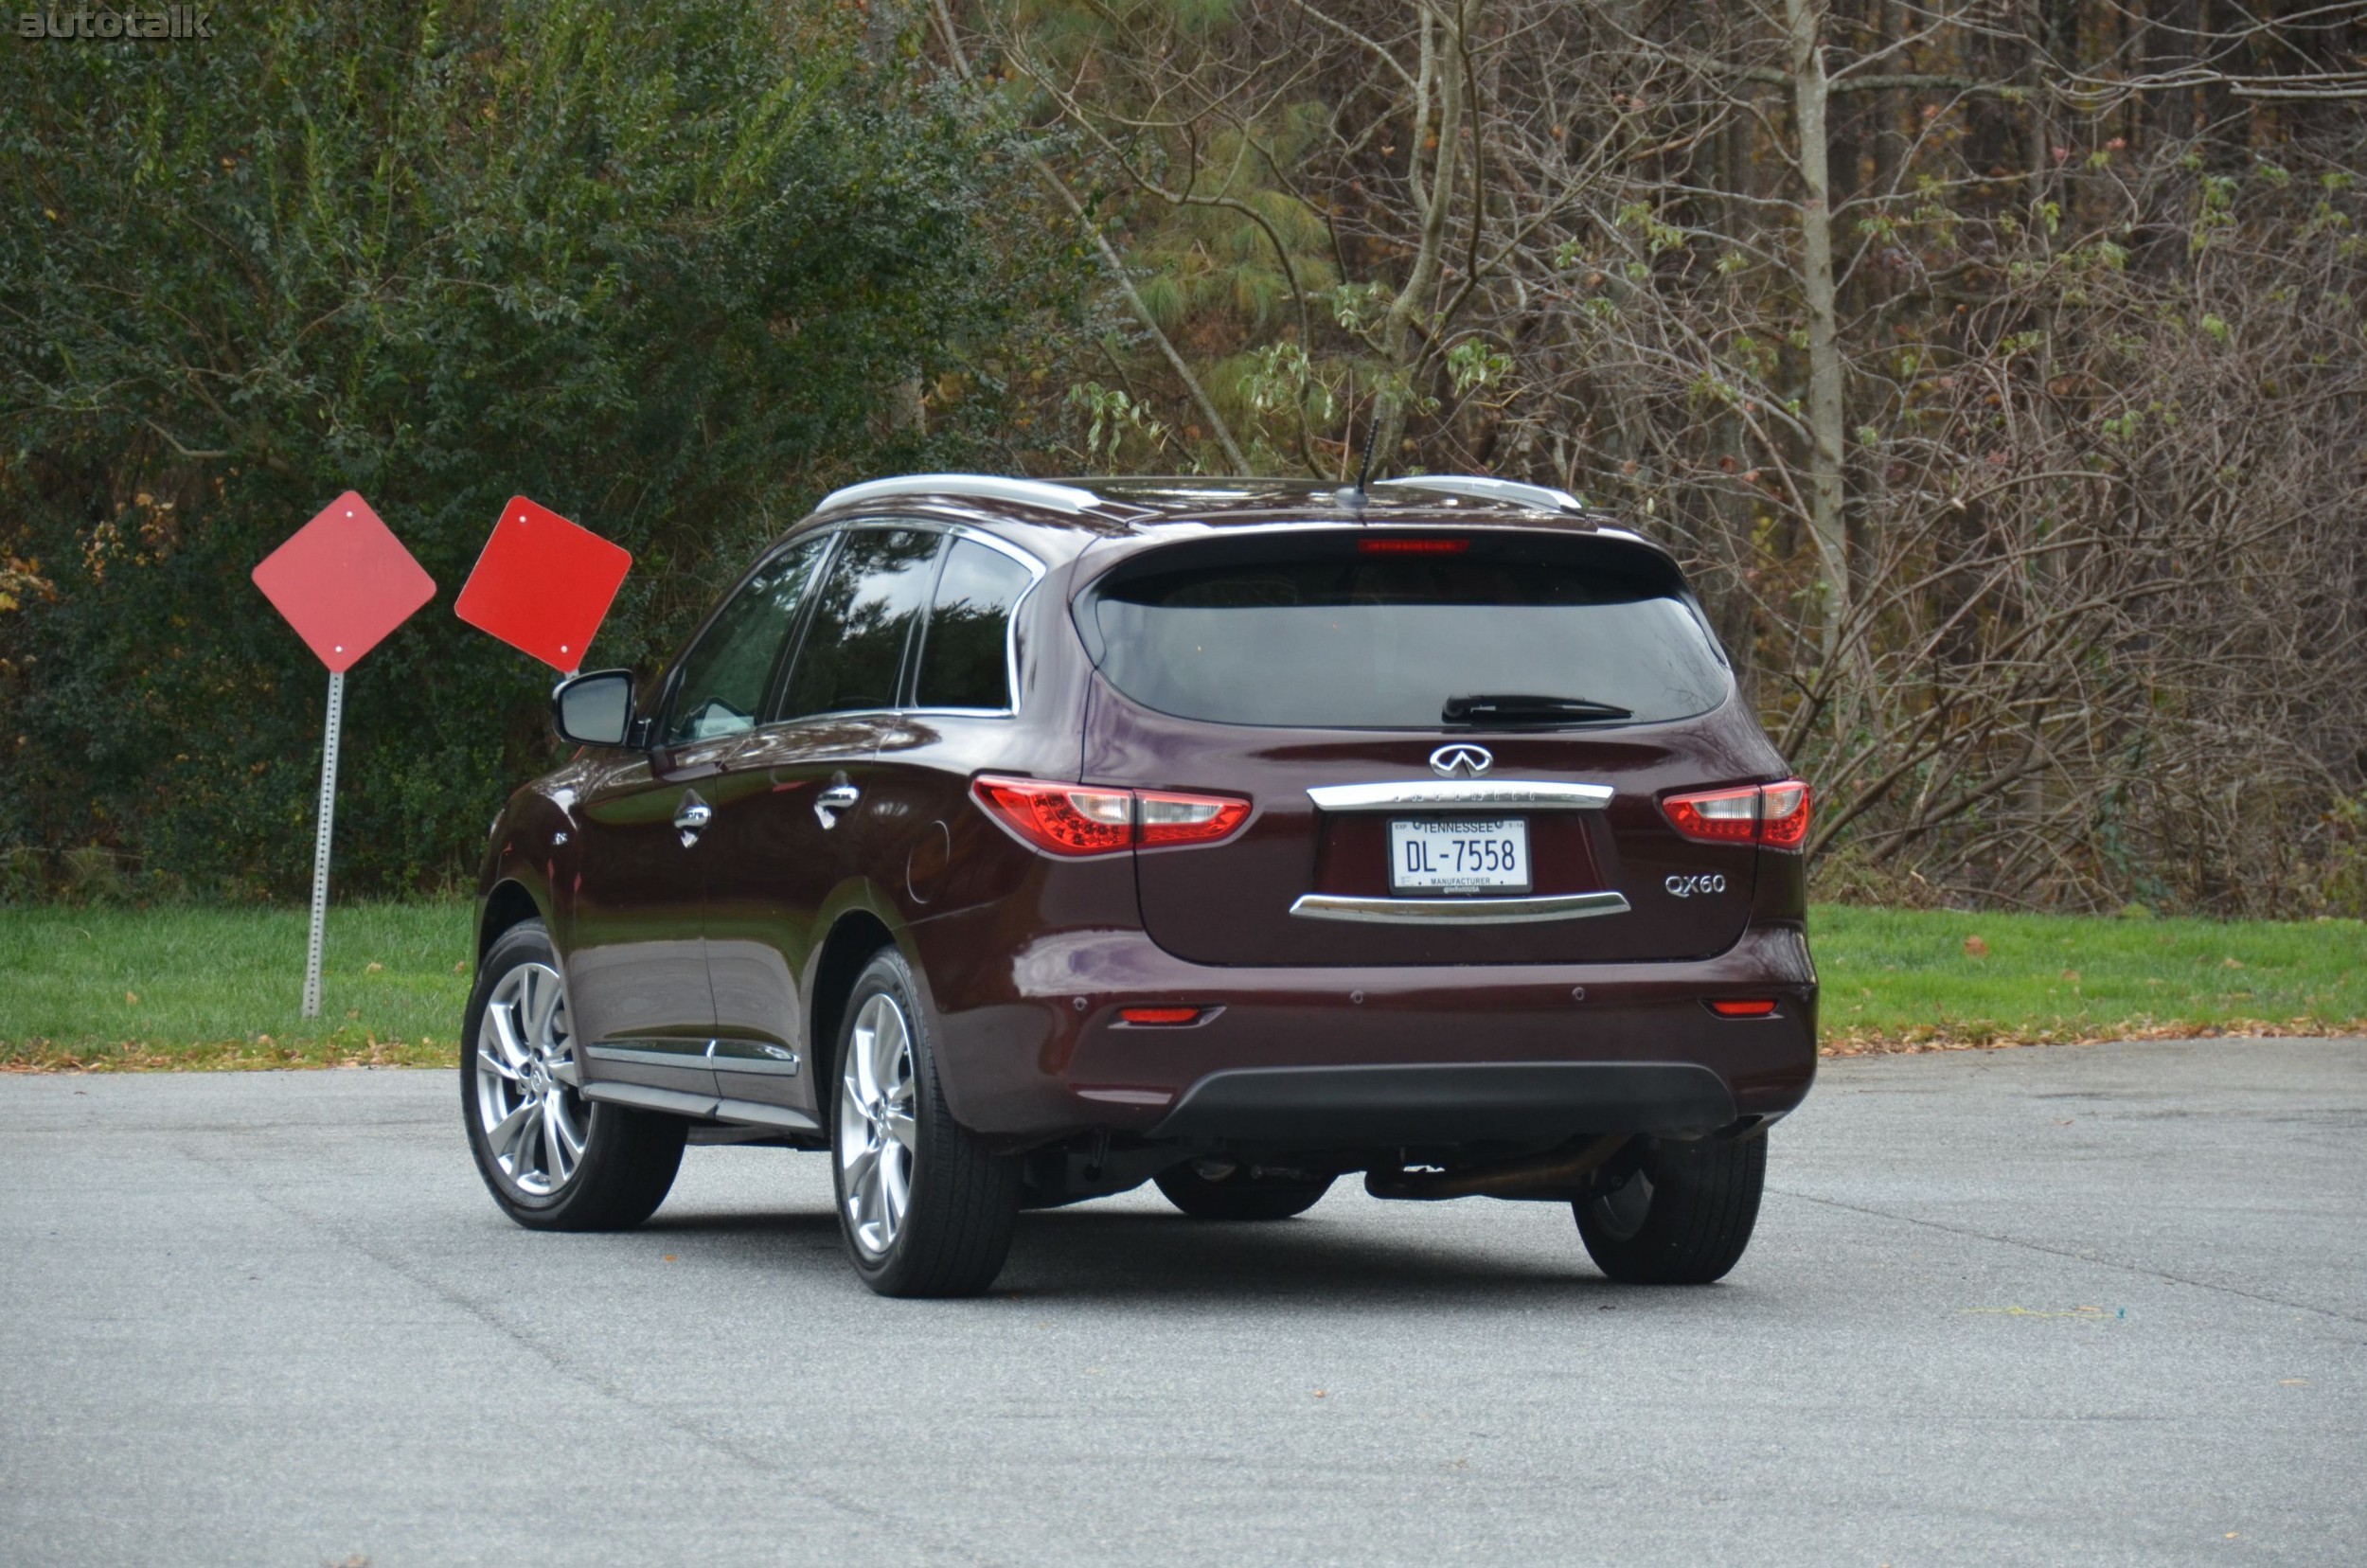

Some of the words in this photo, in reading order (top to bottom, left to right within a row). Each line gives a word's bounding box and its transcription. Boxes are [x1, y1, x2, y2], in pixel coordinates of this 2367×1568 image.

[1423, 822, 1494, 833] TENNESSEE
[1406, 840, 1515, 872] DL-7558
[1431, 877, 1491, 885] MANUFACTURER
[1665, 874, 1726, 898] QX60
